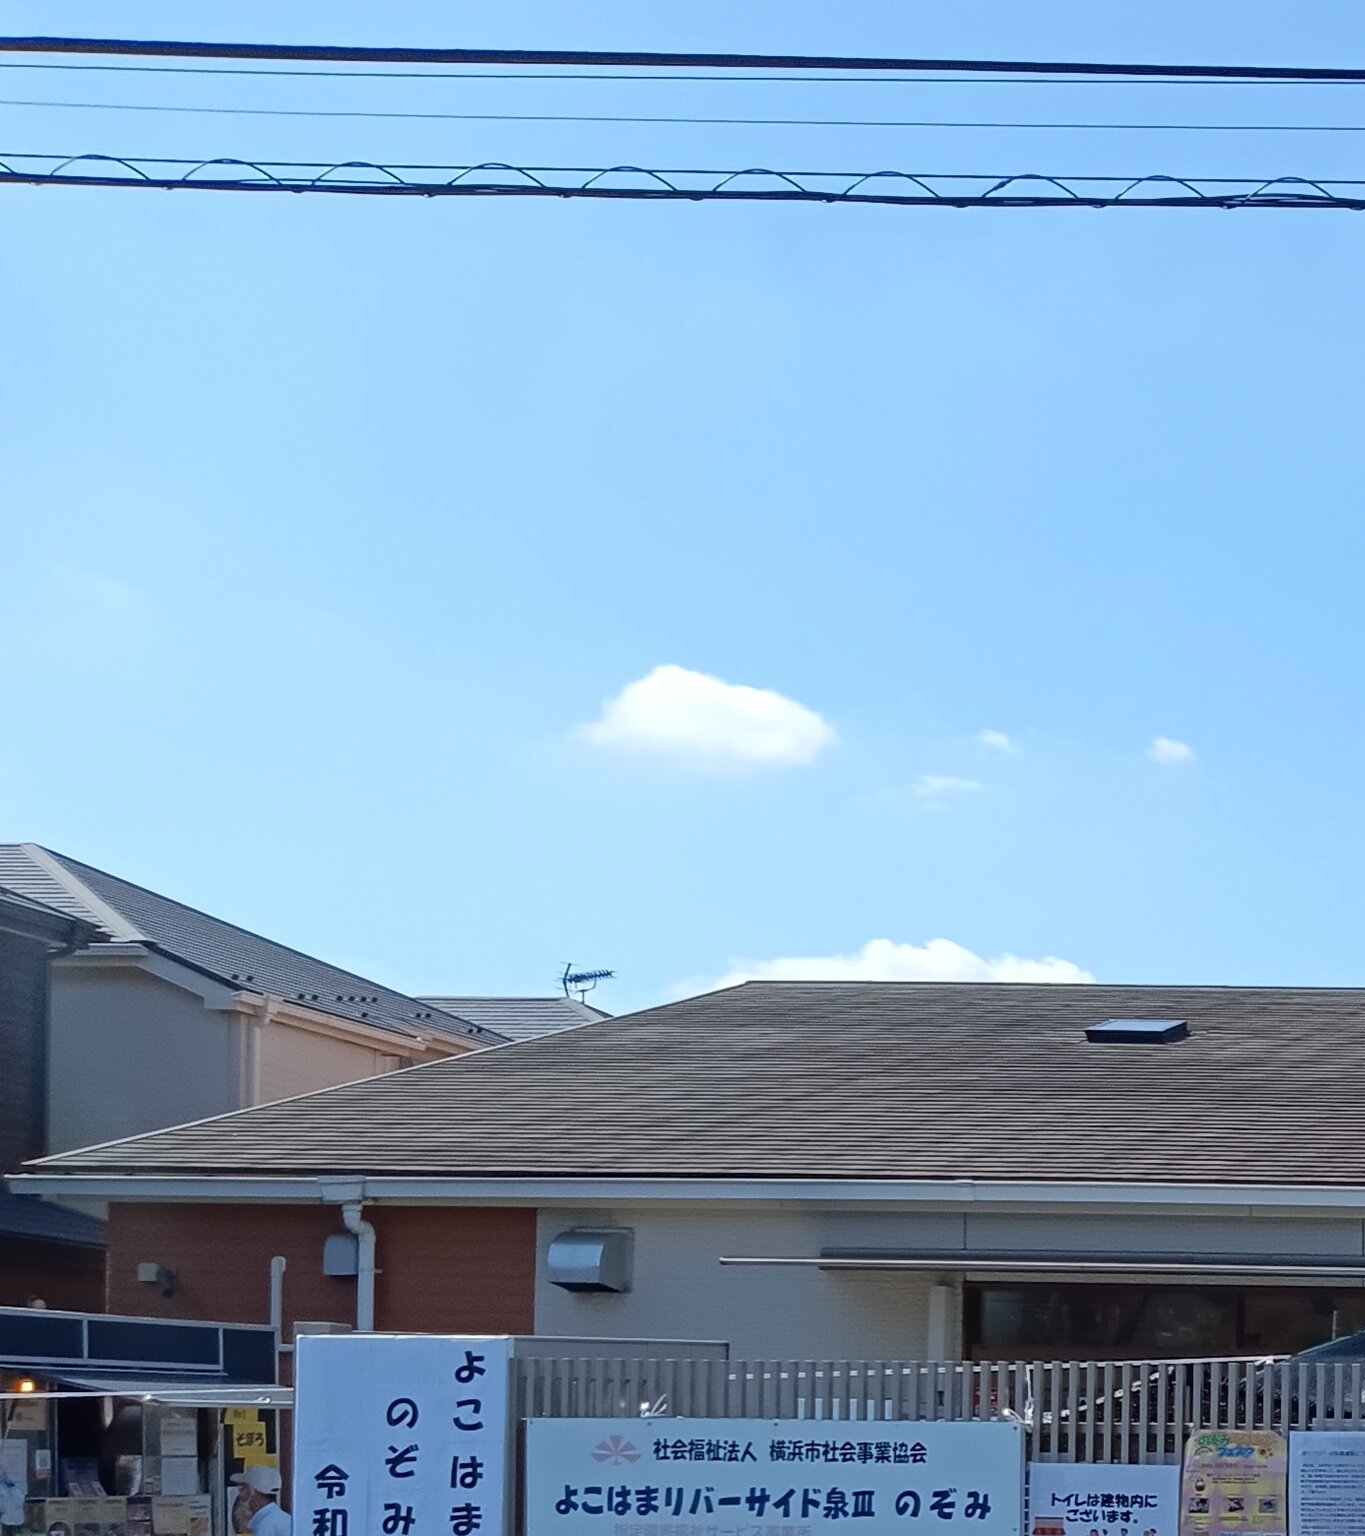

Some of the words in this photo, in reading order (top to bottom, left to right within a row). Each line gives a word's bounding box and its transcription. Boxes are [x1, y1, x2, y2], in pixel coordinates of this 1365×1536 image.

[653, 1438, 757, 1462] 社会福祉法人
[769, 1440, 928, 1464] 横浜市社会事業協会
[894, 1488, 992, 1519] のぞみ
[1051, 1493, 1158, 1508] トイレは建物内に
